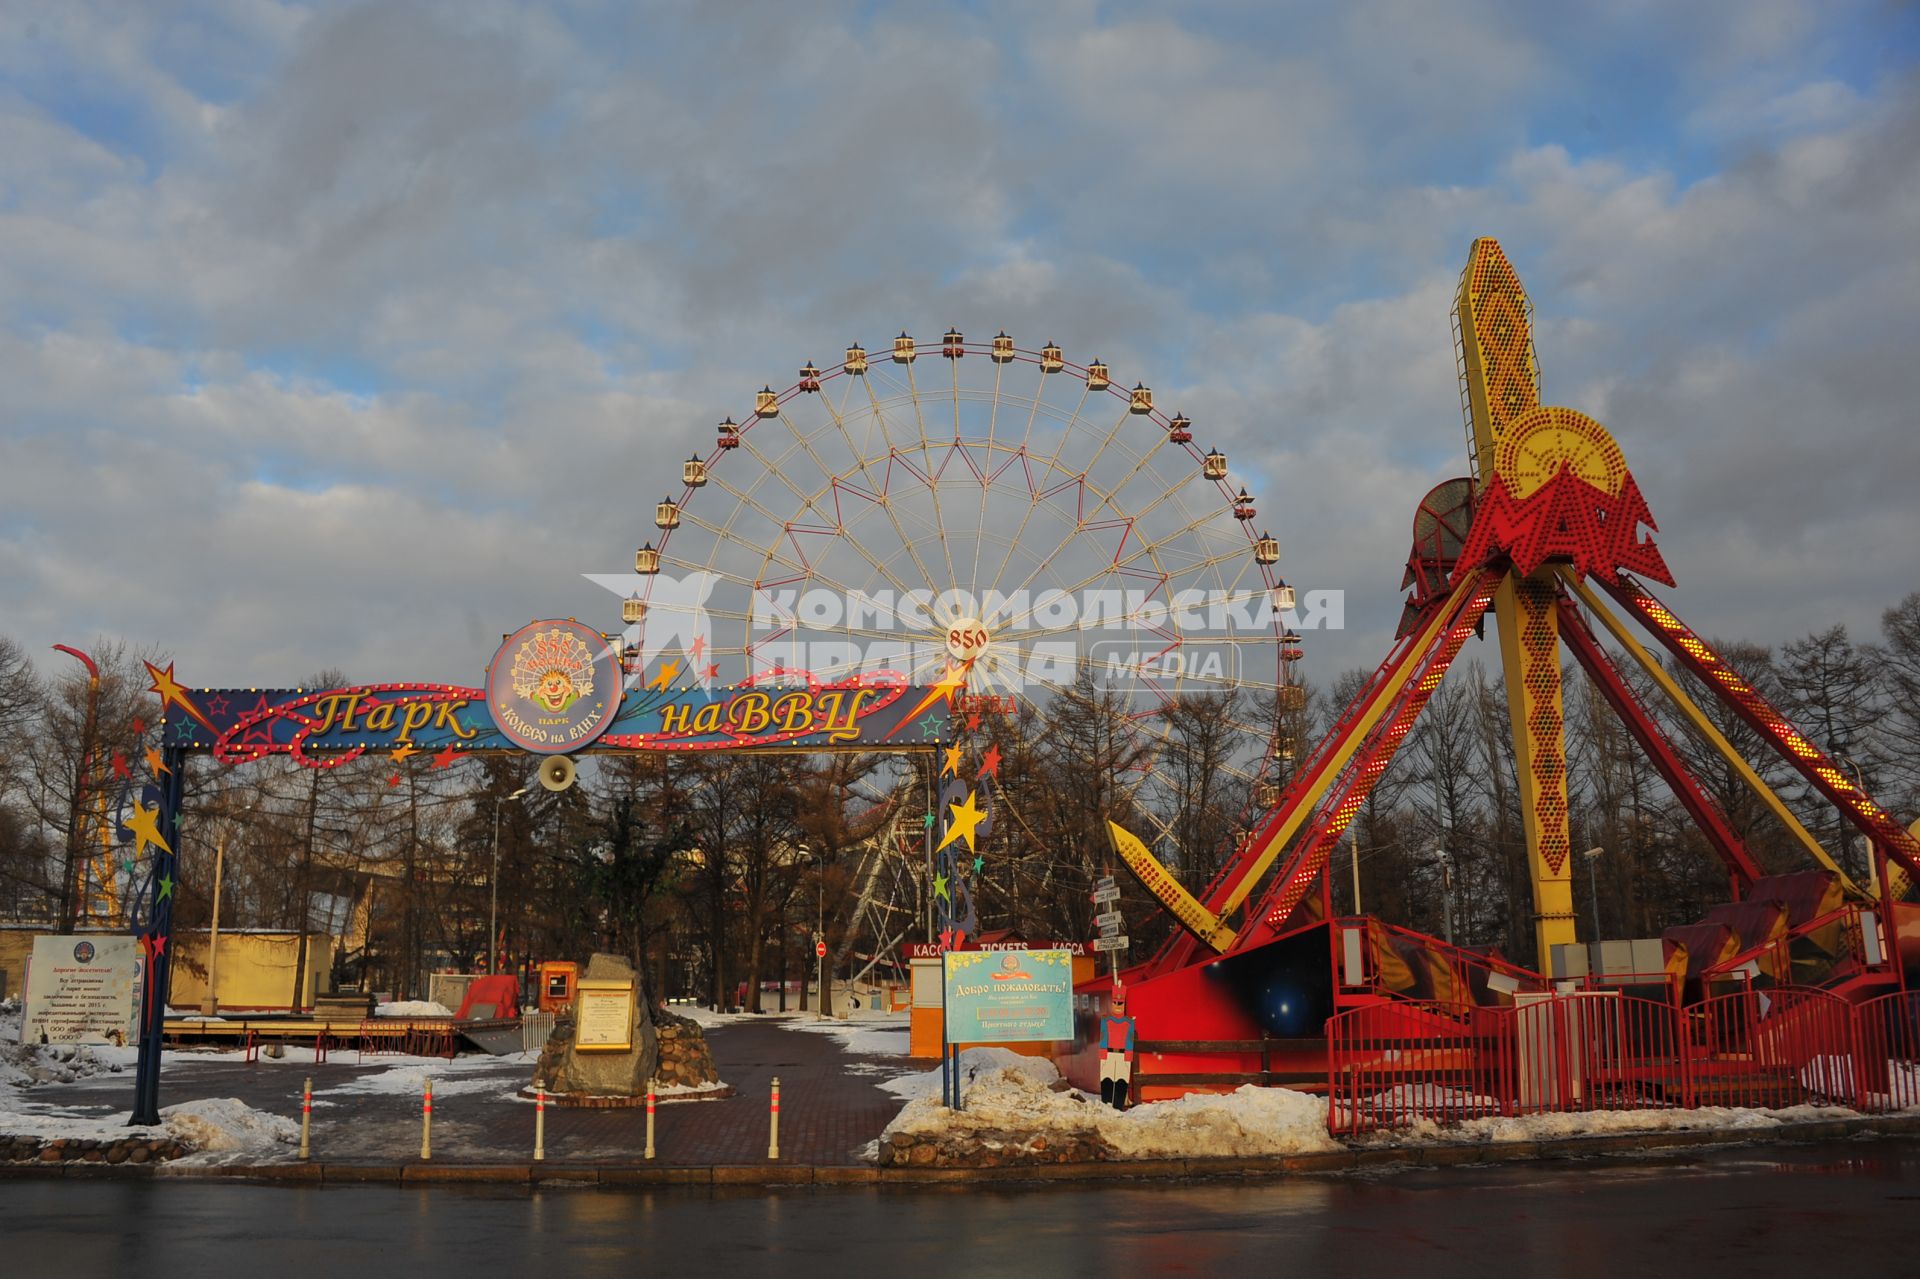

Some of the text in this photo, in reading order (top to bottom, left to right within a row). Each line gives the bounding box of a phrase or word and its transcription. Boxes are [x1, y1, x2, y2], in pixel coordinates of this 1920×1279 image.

[949, 629, 987, 649] 850
[536, 639, 571, 656] 850
[310, 687, 876, 745] Парк на ВВЦ
[538, 717, 570, 725] ПАРК
[569, 710, 602, 740] ВДНХ
[913, 944, 942, 957] КАС
[980, 942, 1029, 952] TICKETS
[993, 981, 1067, 994] пожаловать!
